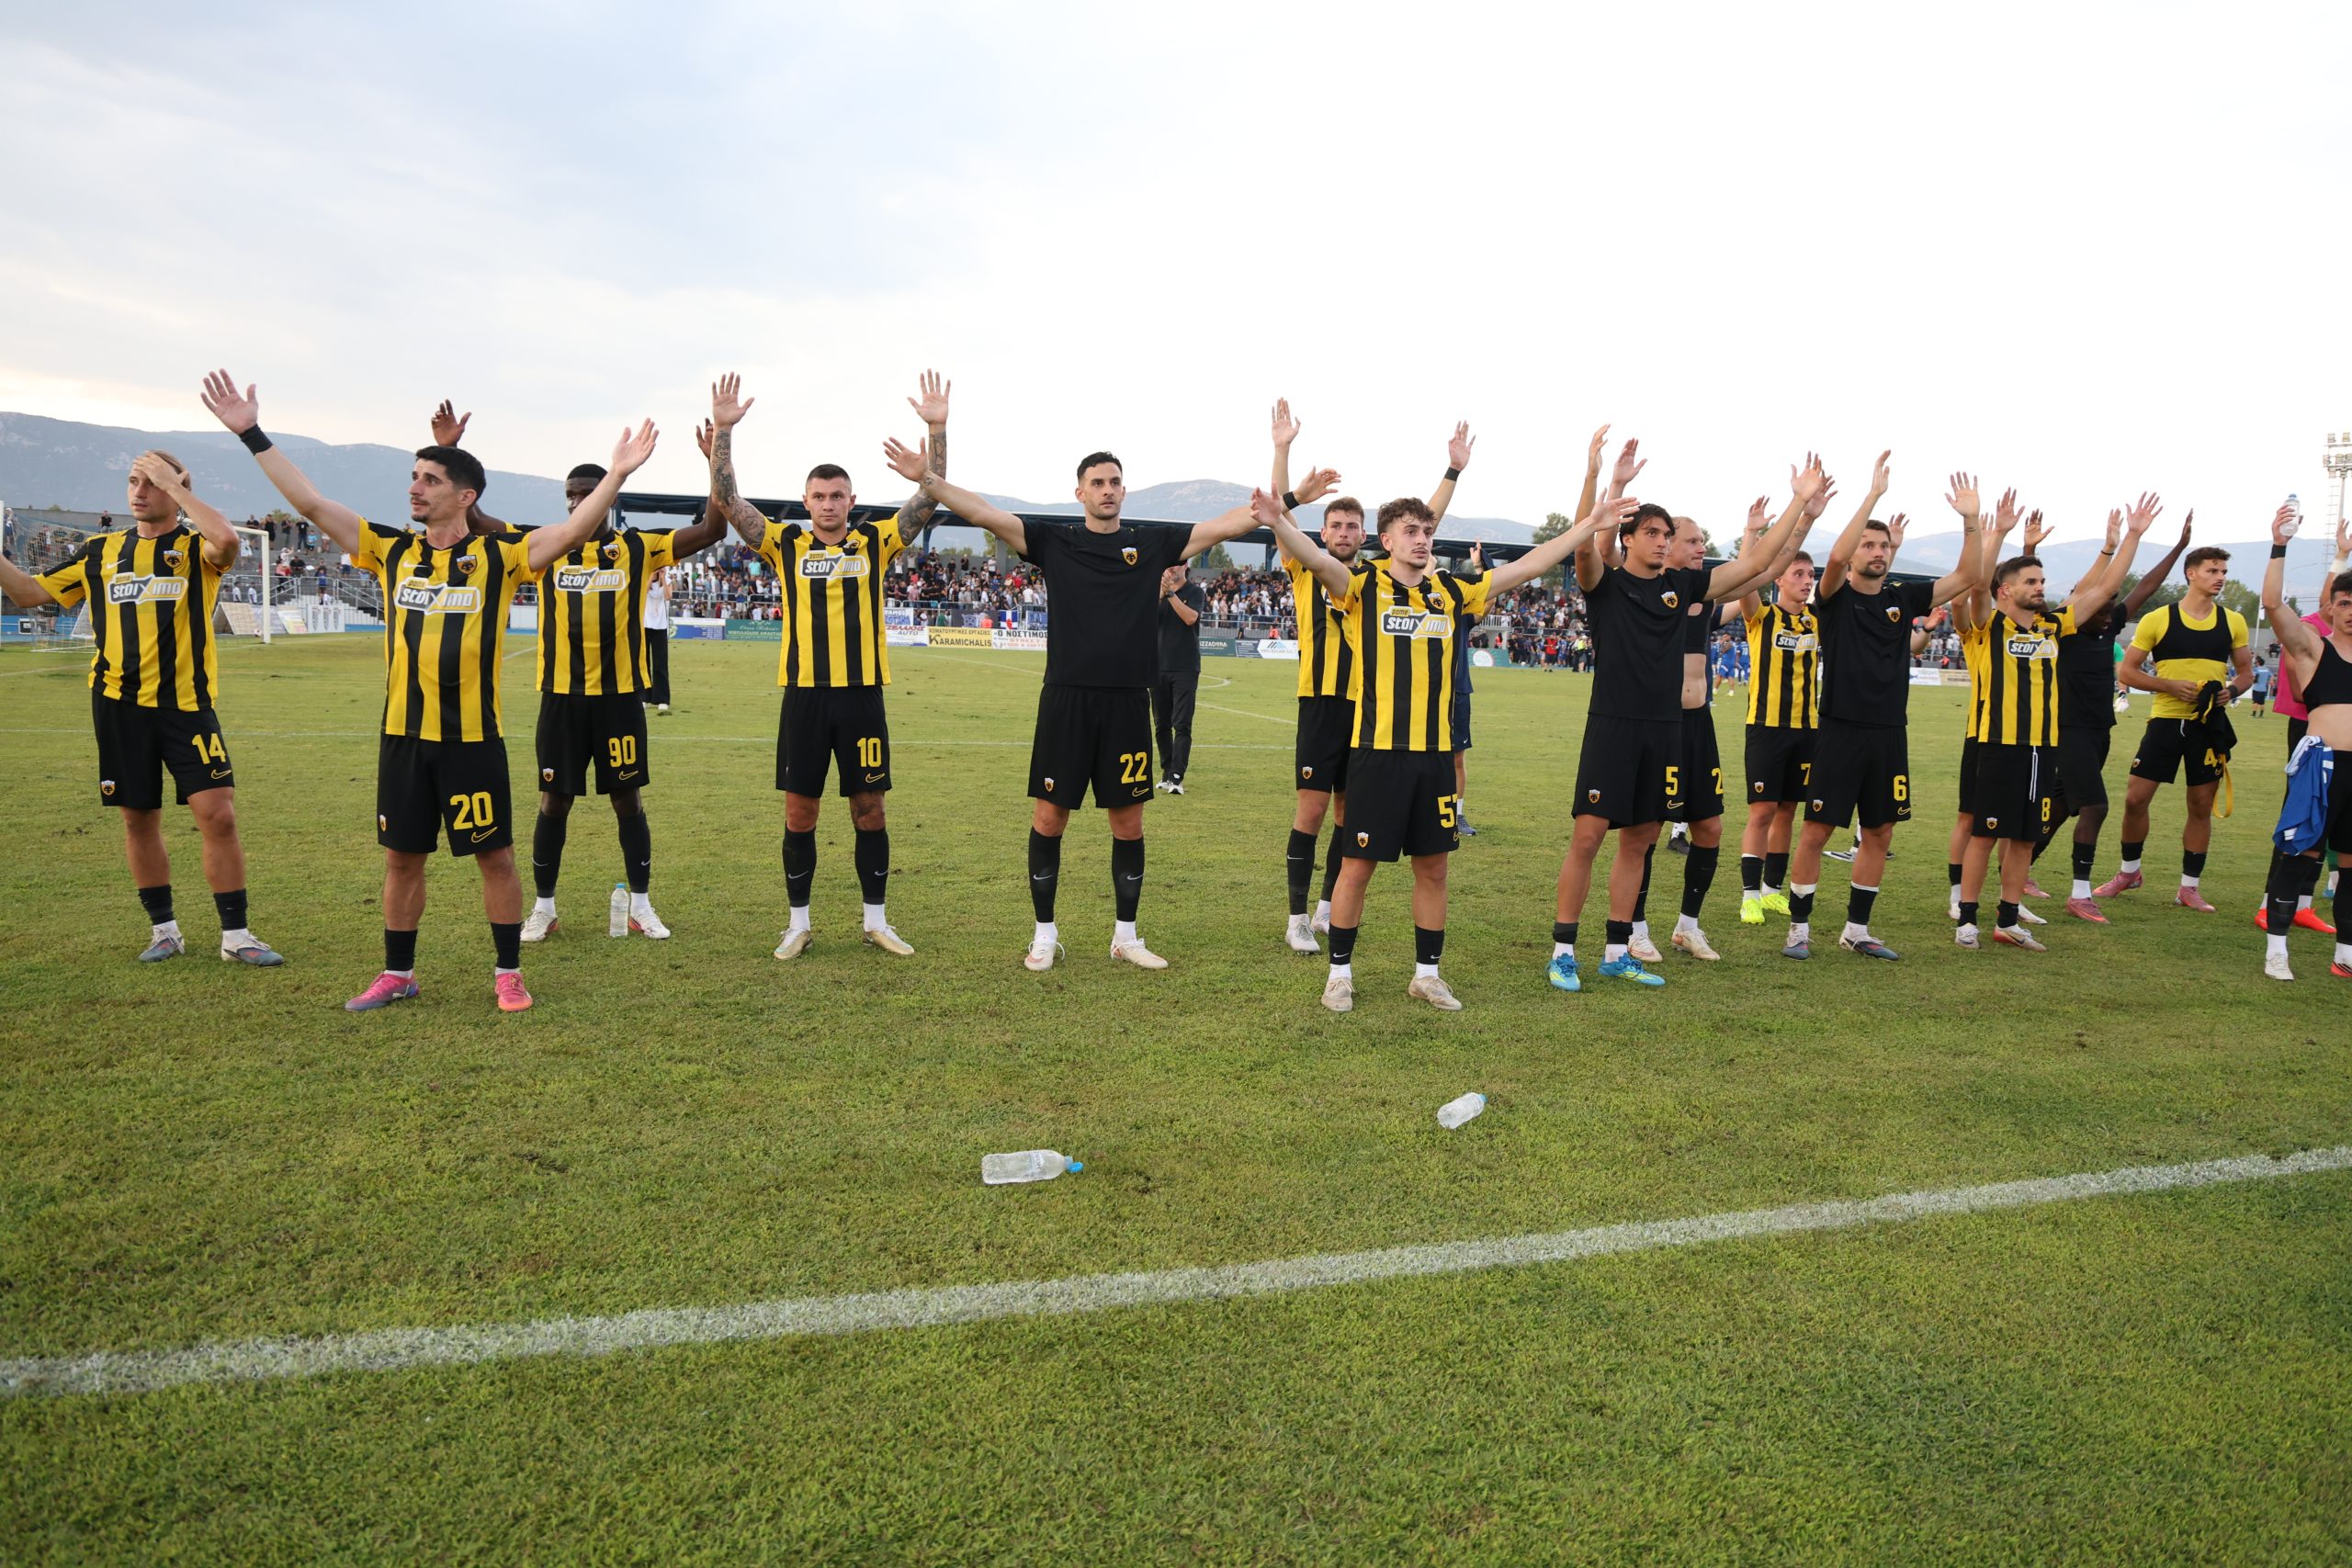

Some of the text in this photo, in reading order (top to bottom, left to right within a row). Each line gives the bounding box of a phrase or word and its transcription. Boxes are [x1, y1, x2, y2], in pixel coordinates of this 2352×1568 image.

[929, 634, 992, 647] KARAMICHALIS
[192, 733, 226, 764] 14
[608, 735, 636, 767] 90
[856, 738, 881, 767] 10
[1120, 751, 1148, 784] 22
[1665, 766, 1679, 795] 5
[1894, 774, 1906, 801] 6
[450, 791, 493, 830] 20
[2041, 797, 2051, 822] 8
